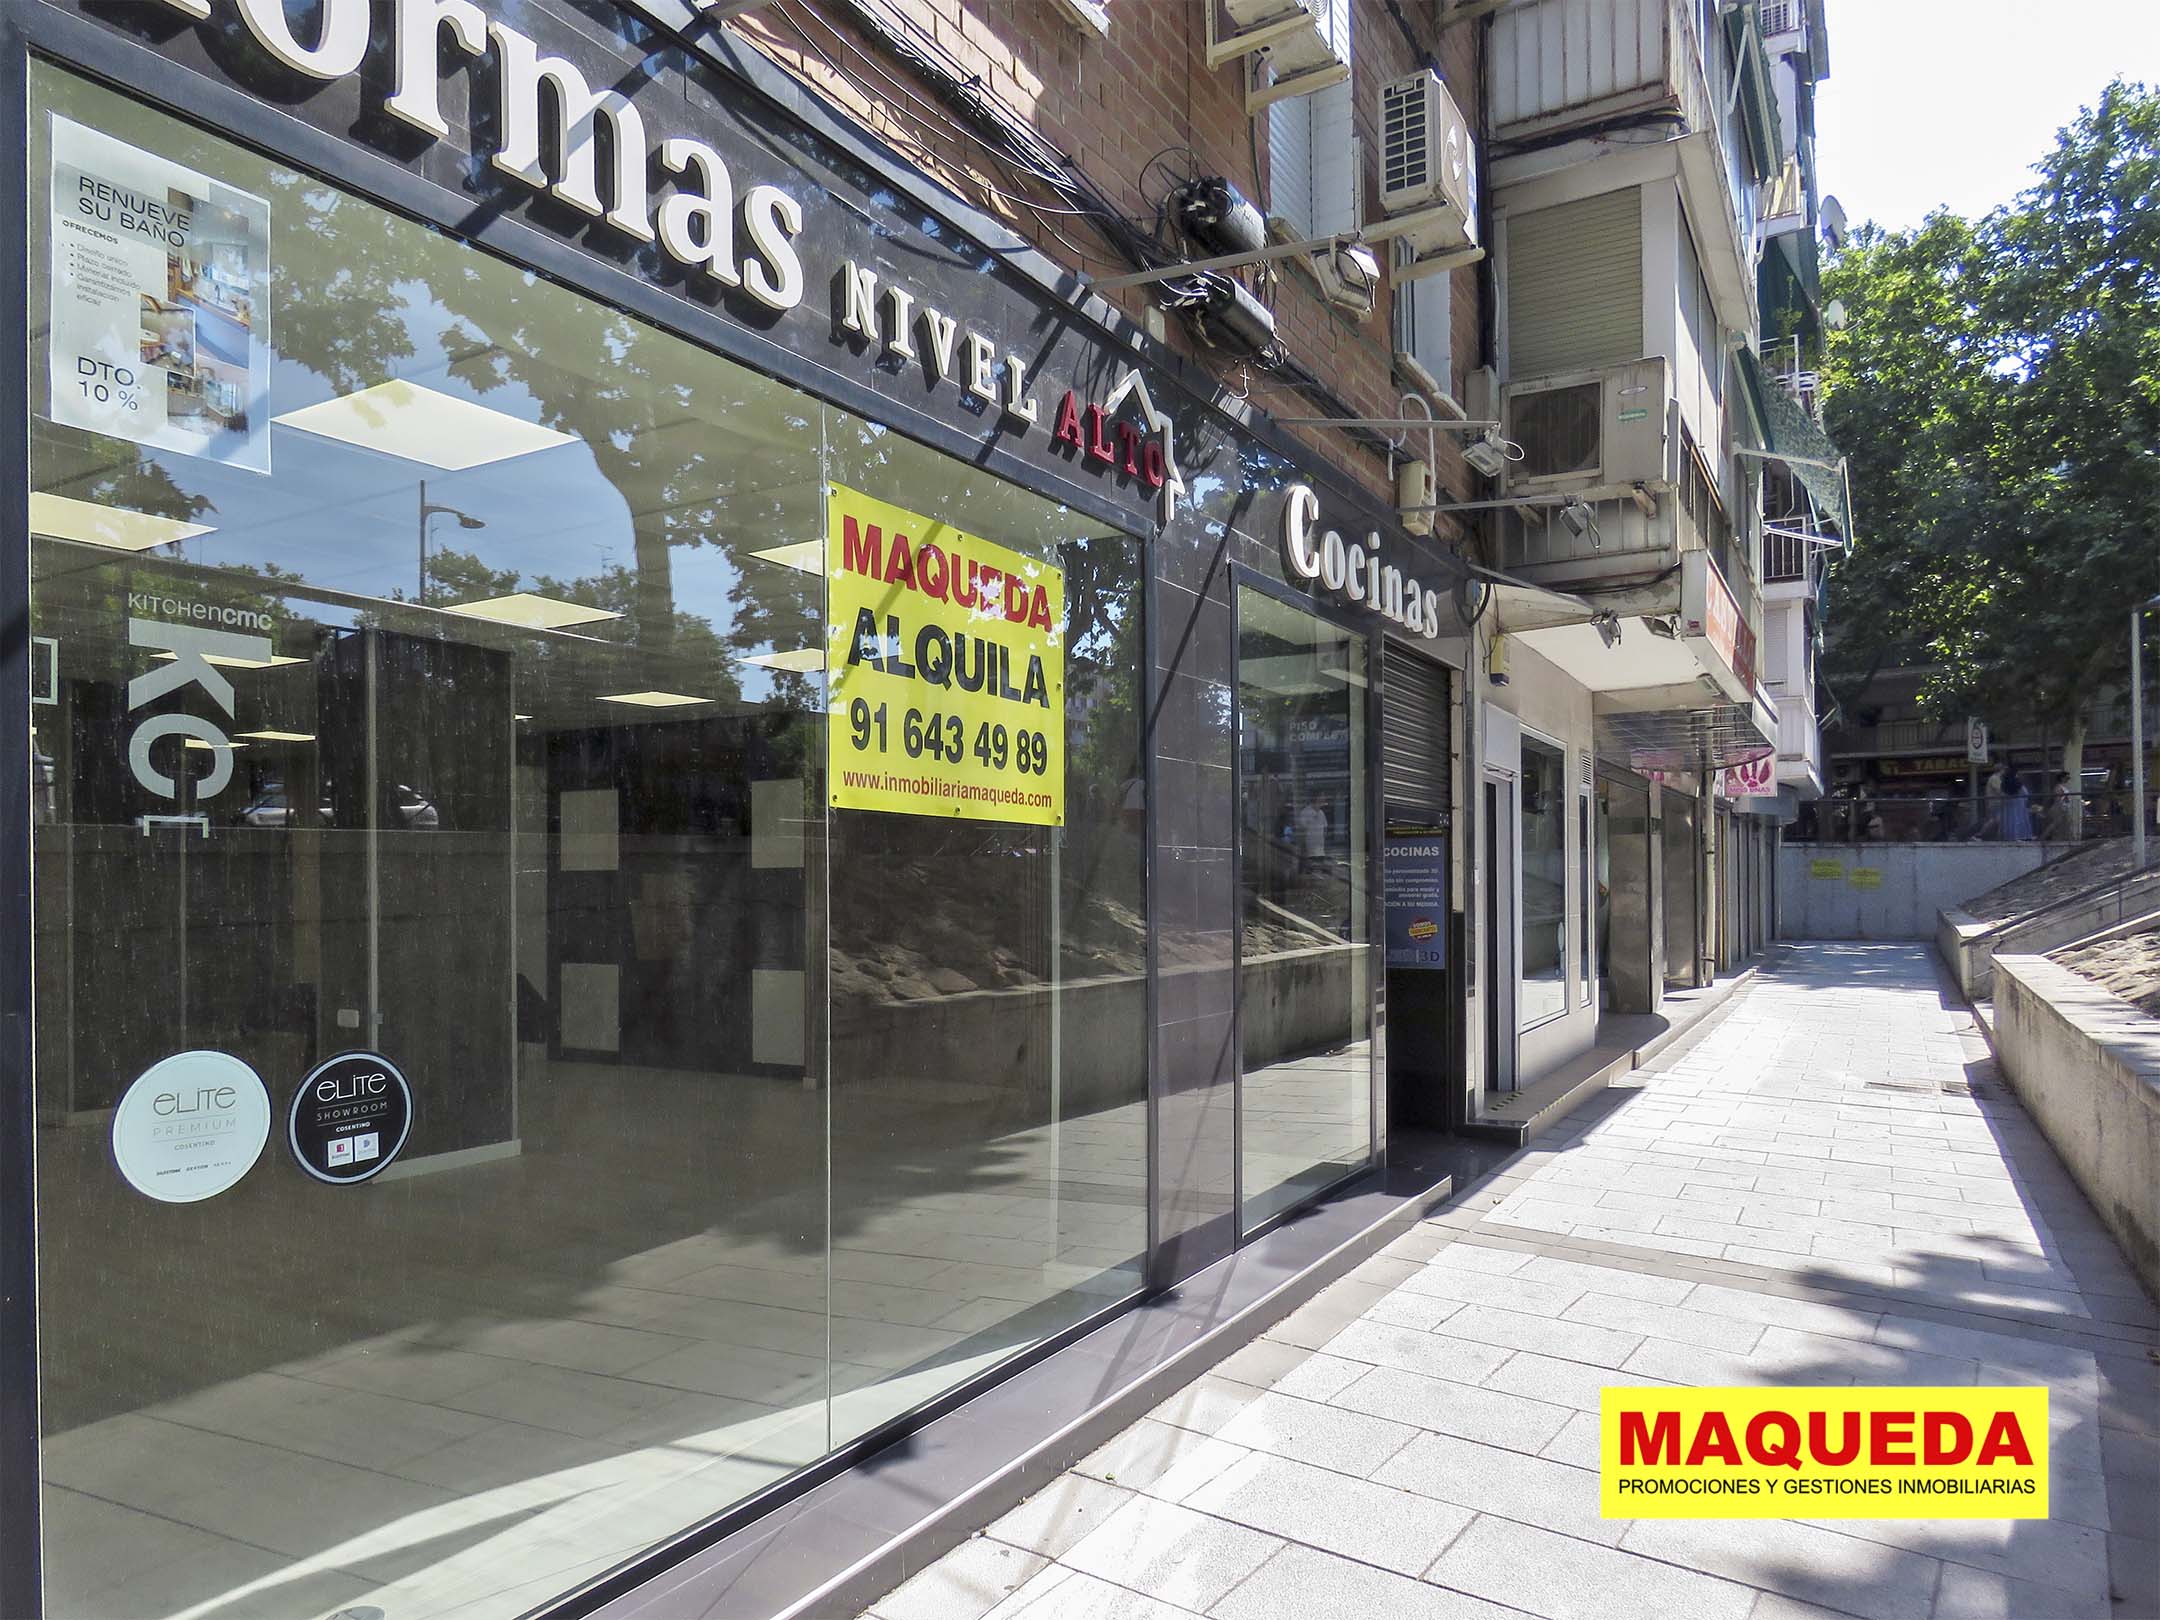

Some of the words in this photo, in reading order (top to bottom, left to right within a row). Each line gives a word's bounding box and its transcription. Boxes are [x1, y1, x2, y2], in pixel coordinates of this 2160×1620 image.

[79, 175, 190, 232] RENUEVE
[62, 219, 118, 245] OFRECEMOS
[78, 197, 111, 222] SU
[120, 211, 185, 248] BAÑO
[161, 0, 804, 310] ormas
[842, 259, 1037, 423] NIVEL
[1056, 390, 1165, 488] ALTO
[1285, 485, 1439, 639] Cocinas
[78, 355, 141, 391] DTO.
[78, 381, 109, 403] 10
[118, 390, 138, 411] %
[842, 513, 1052, 633] MAQUEDA
[847, 606, 1051, 708] ALQUILA
[850, 697, 887, 753] 91
[903, 708, 964, 764] 643
[974, 721, 1008, 770] 49
[1016, 729, 1048, 776] 89
[843, 770, 1052, 808] www.inmobiliariamaqueda.com
[1384, 846, 1440, 857] COCINAS
[153, 1118, 236, 1138] PREMIUM
[316, 1101, 388, 1121] SHOWROOM
[335, 1121, 371, 1133] COSENTINO
[174, 1139, 216, 1151] COSENTINO
